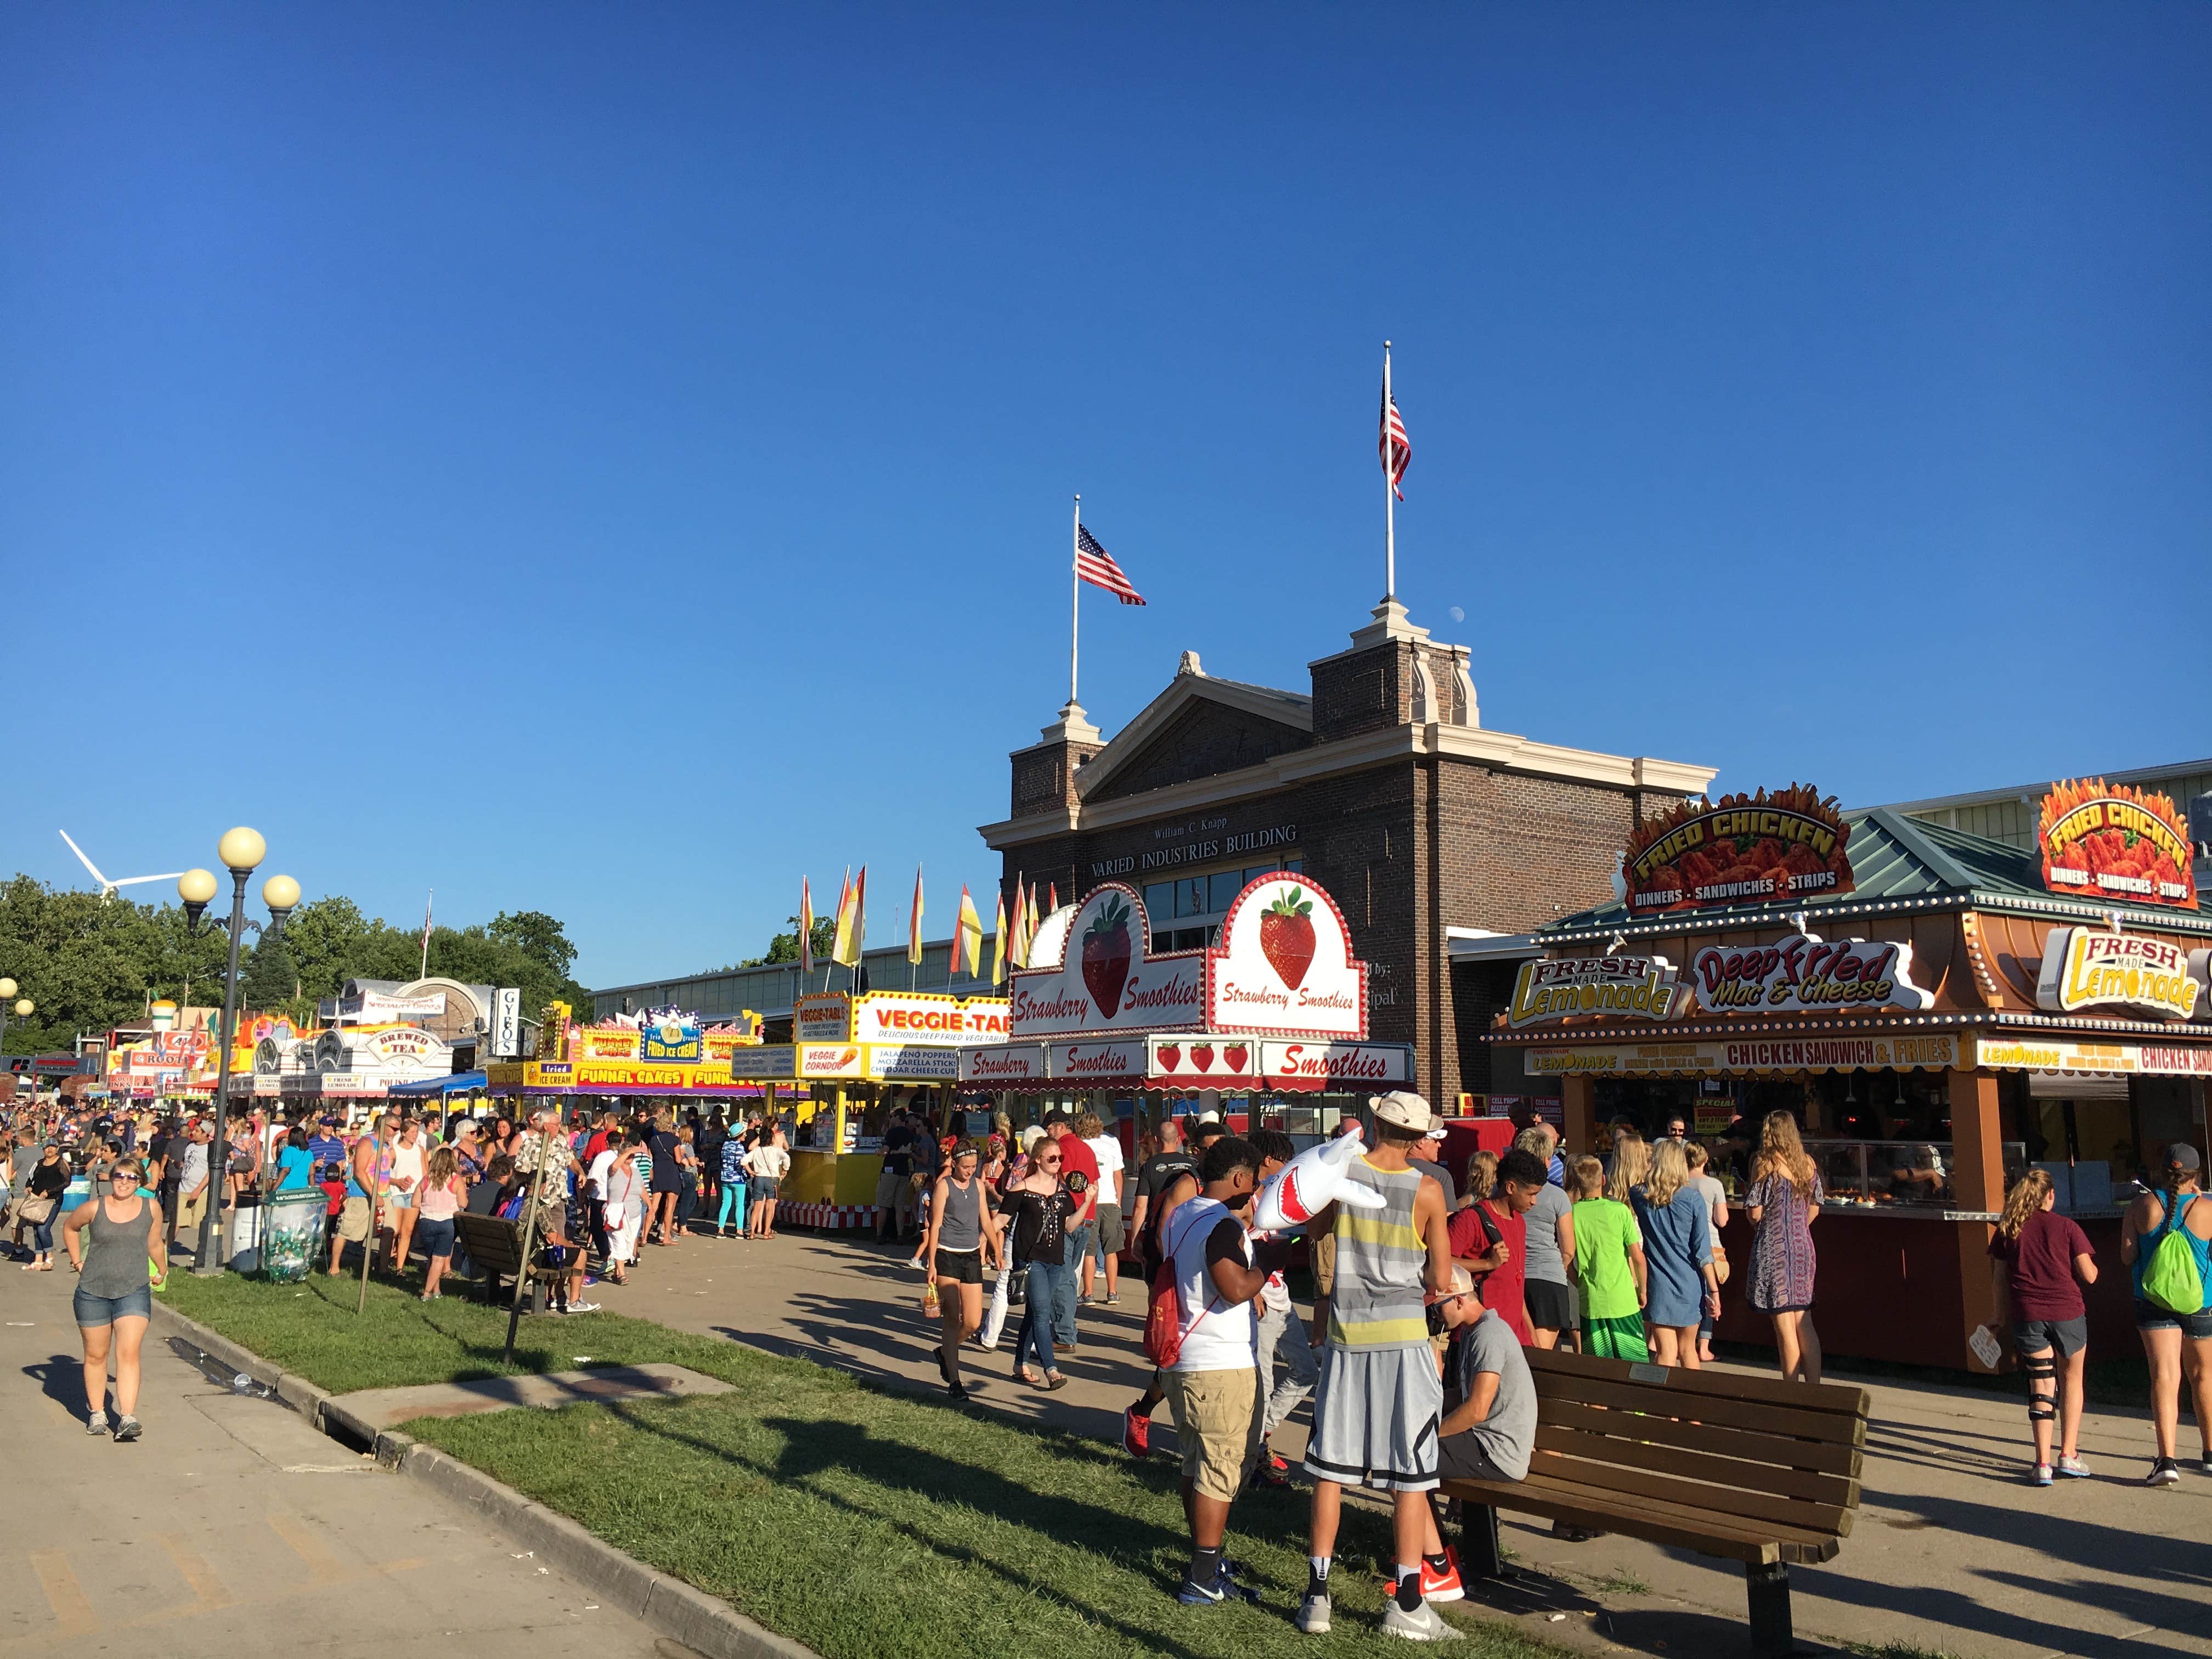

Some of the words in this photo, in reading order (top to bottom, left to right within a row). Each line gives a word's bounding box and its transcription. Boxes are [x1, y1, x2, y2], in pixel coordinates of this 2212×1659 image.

[1155, 827, 1184, 839] William
[1201, 817, 1227, 830] Knapp
[2050, 804, 2103, 854] FRIED
[2107, 803, 2187, 868] CHICKEN
[1092, 856, 1134, 877] VARIED
[1142, 840, 1218, 869] INDUSTRIES
[1226, 825, 1297, 854] BUILDING
[1635, 822, 1703, 879] FRIED
[1712, 811, 1835, 855] CHICKEN
[1635, 889, 1683, 906] DINNERS
[1695, 878, 1774, 900] SANDWICHES
[1788, 871, 1835, 890] STRIPS
[2050, 866, 2089, 885] DINNERS
[2097, 873, 2152, 894] SANDWICHES
[2159, 882, 2187, 899] STRIPS
[1699, 948, 1780, 994] Deep
[1781, 938, 1894, 986] Fried
[2086, 938, 2179, 970] FRESH
[2117, 957, 2144, 969] MADE
[1533, 958, 1648, 985] FRESH
[1573, 974, 1607, 985] MADE
[2067, 935, 2197, 1011] Lemonade
[1015, 988, 1089, 1026] Strawberry
[1124, 972, 1199, 1010] Smoothies
[1222, 983, 1289, 1011] Strawberry
[1298, 988, 1353, 1009] Smoothies
[1513, 963, 1673, 1022] Lemonade
[1710, 978, 1765, 1007] Mac
[1768, 977, 1793, 1005] &
[1797, 974, 1893, 1004] Cheese
[379, 1032, 428, 1046] BREWED
[592, 1037, 635, 1048] FUNNEL
[878, 1030, 918, 1039] DELICIOUS
[391, 1044, 417, 1053] TEA
[595, 1047, 631, 1058] CAKES
[647, 1040, 665, 1057] FRIED
[666, 1047, 676, 1057] ICE
[677, 1041, 697, 1058] CREAM
[809, 1052, 836, 1060] VEGGIE
[1066, 1045, 1127, 1073] Smoothies
[1280, 1045, 1387, 1078] Smoothies
[1728, 1043, 1804, 1065] CHICKEN
[1806, 1041, 1874, 1065] SANDWICH
[1875, 1043, 1891, 1064] &
[1894, 1037, 1952, 1063] FRIES
[1983, 1045, 2060, 1066] LEMONADE
[2142, 1047, 2191, 1070] CHICKEN
[2193, 1049, 2212, 1071] SAND
[805, 1062, 843, 1071] CORNDOG
[972, 1051, 1030, 1077] Strawberry
[1533, 1054, 1617, 1070] LEMONADE
[550, 1076, 571, 1084] CREAM
[580, 1069, 634, 1084] FUNNEL
[637, 1070, 681, 1085] CAKES
